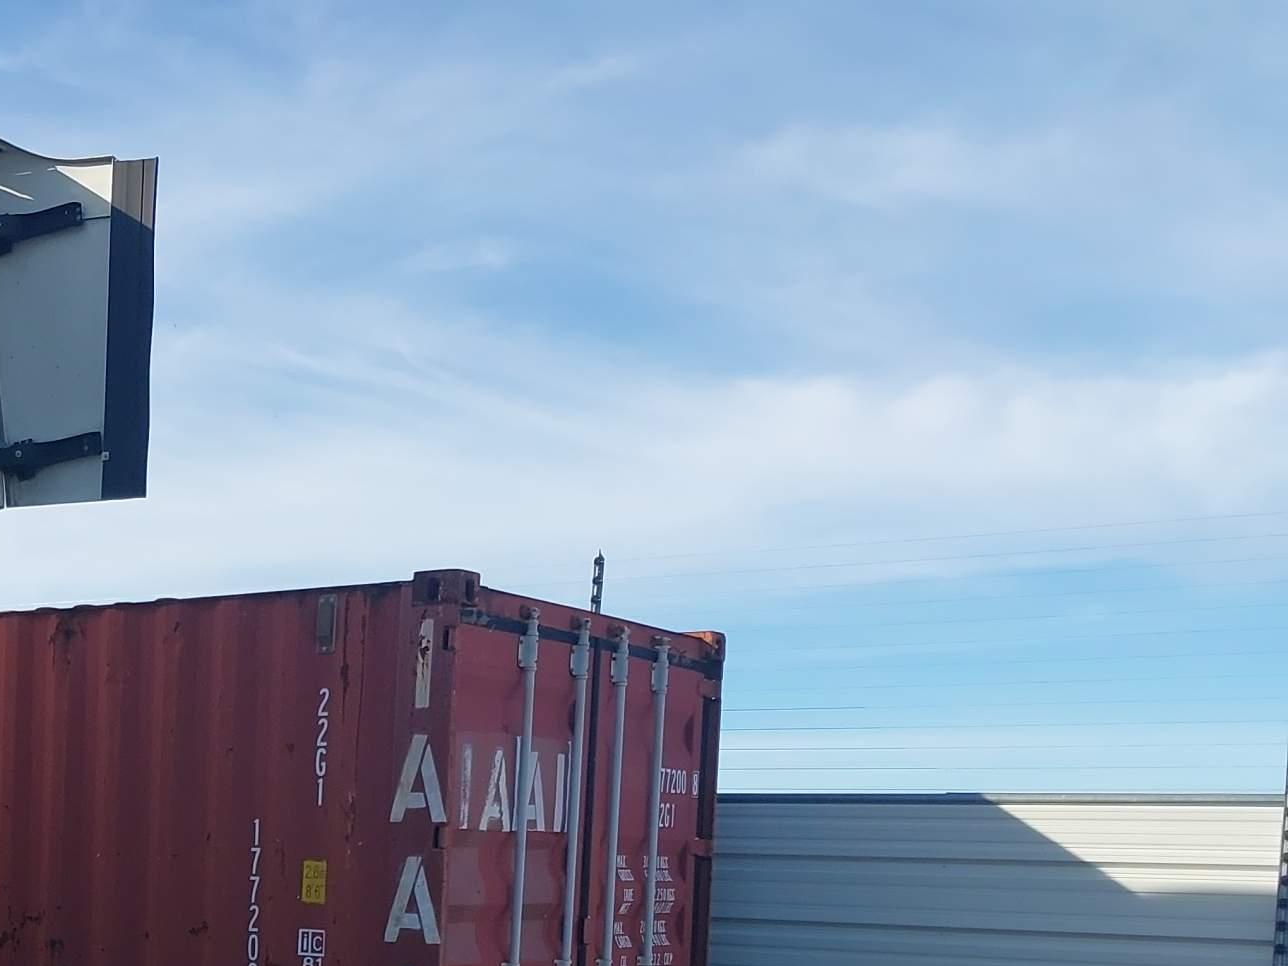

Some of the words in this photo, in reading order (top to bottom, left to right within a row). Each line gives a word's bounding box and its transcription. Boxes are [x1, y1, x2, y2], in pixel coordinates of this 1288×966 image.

[315, 688, 330, 806] 22G1
[660, 768, 687, 794] 77200
[659, 803, 675, 828] 2G1
